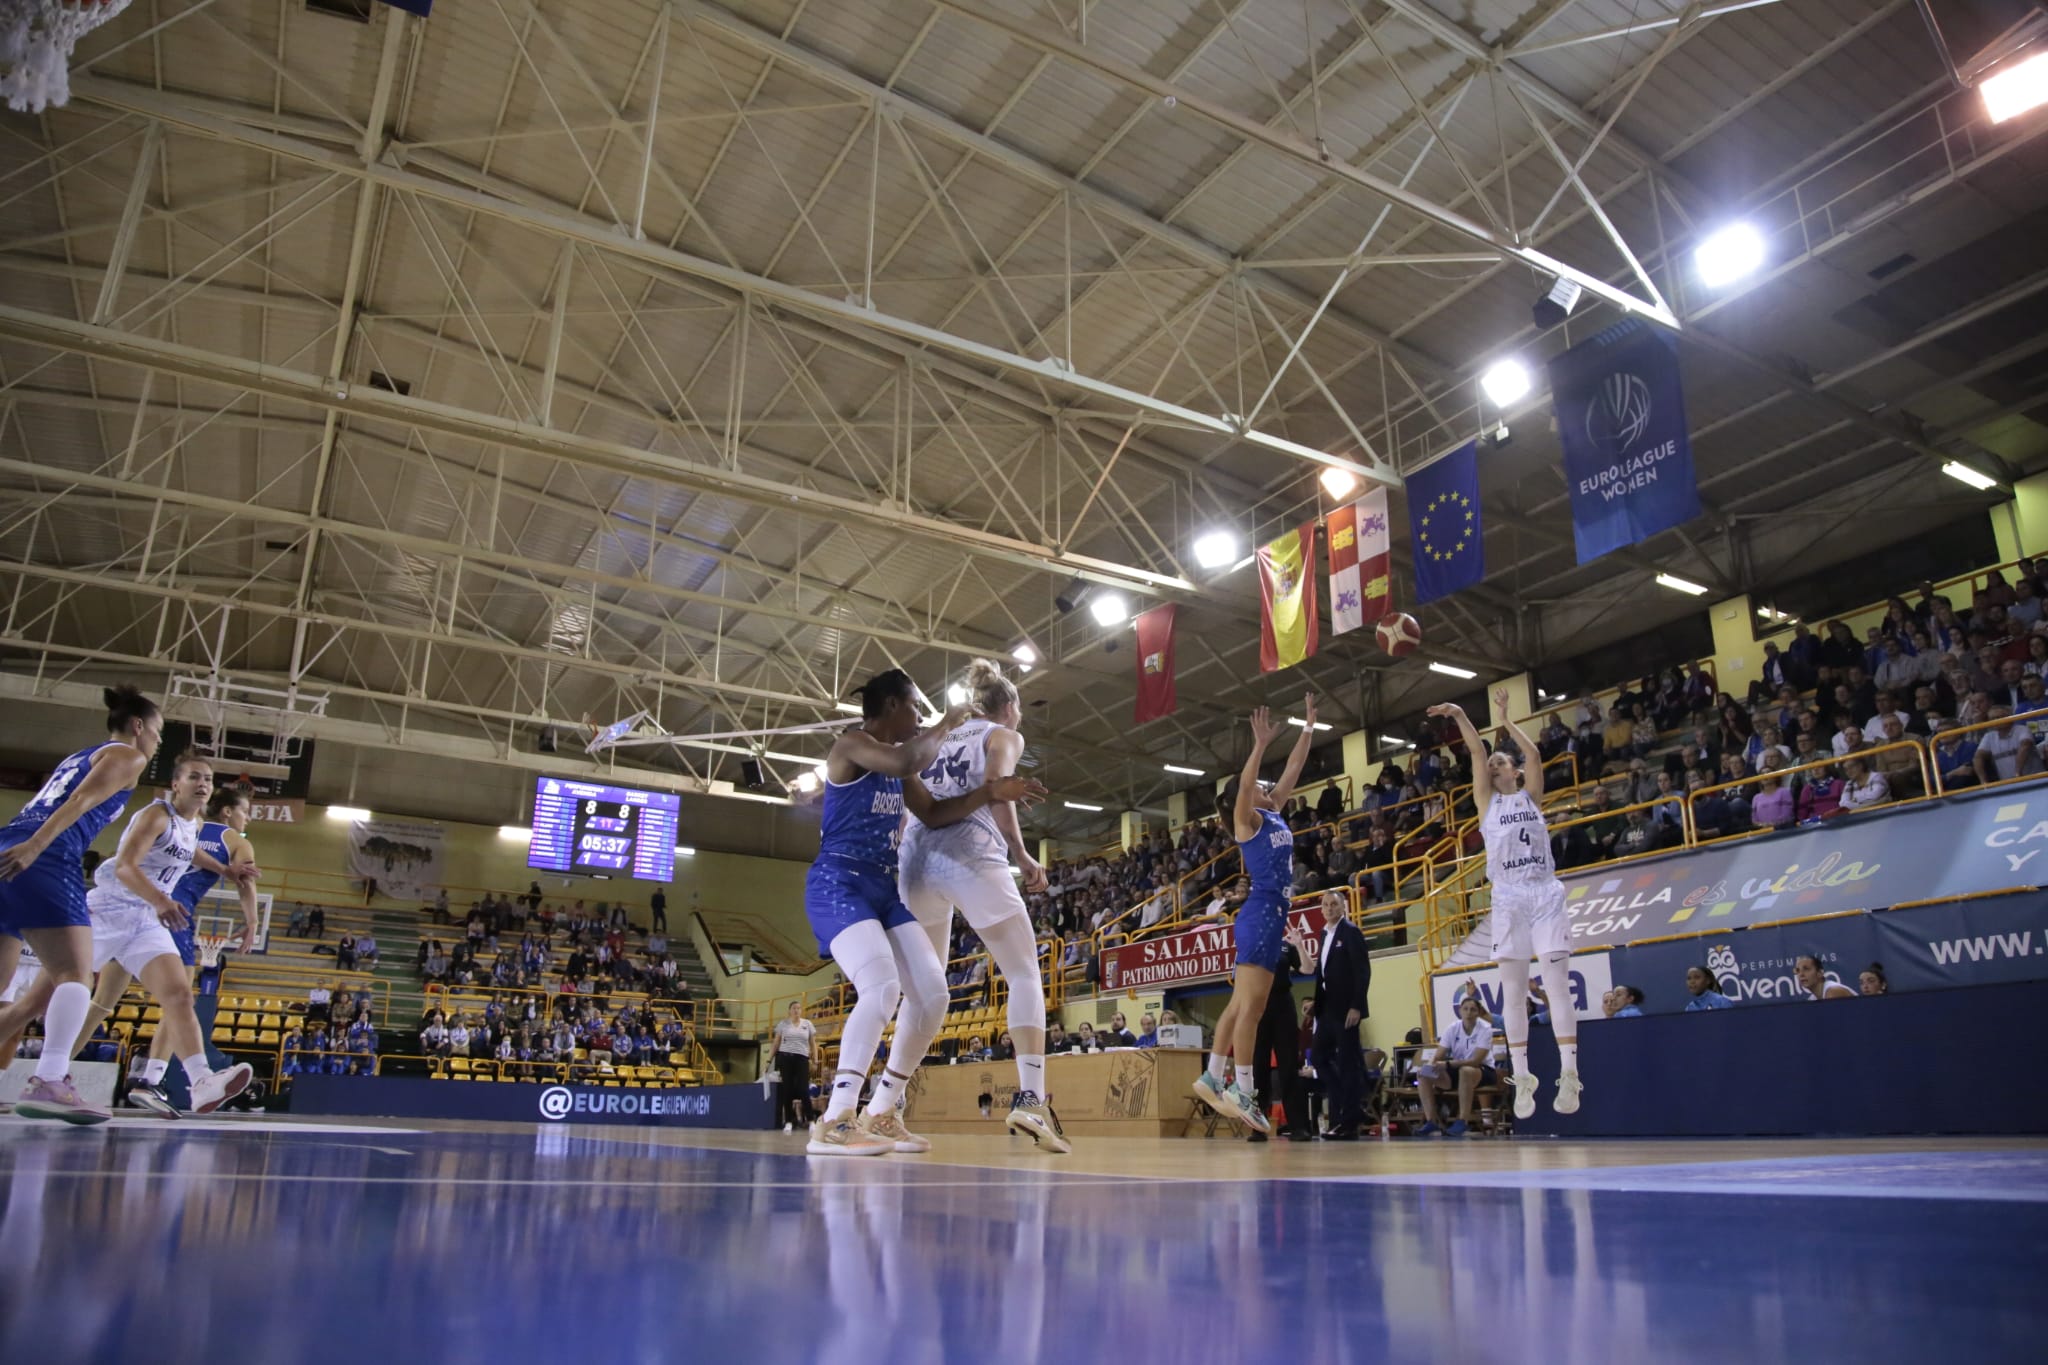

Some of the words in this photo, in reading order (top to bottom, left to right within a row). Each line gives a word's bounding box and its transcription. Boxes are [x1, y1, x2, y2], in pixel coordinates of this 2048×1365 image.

[1579, 440, 1676, 495] EUROLEAGUE
[1601, 467, 1658, 502] WOMEN
[250, 804, 294, 822] ETA
[585, 800, 597, 815] 8
[618, 804, 631, 819] 8
[582, 835, 626, 853] 05:37
[1519, 827, 1531, 846] 4
[583, 852, 591, 864] 1
[615, 856, 623, 868] 1
[2005, 849, 2041, 872] Y
[157, 865, 178, 884] 10
[1682, 880, 1727, 907] es
[1740, 851, 1882, 900] vida
[1567, 886, 1672, 918] STILLA
[1570, 913, 1642, 938] EÓN
[1928, 929, 2048, 965] WWW.
[1121, 959, 1199, 986] PATRIMONIO
[1202, 955, 1221, 973] DE
